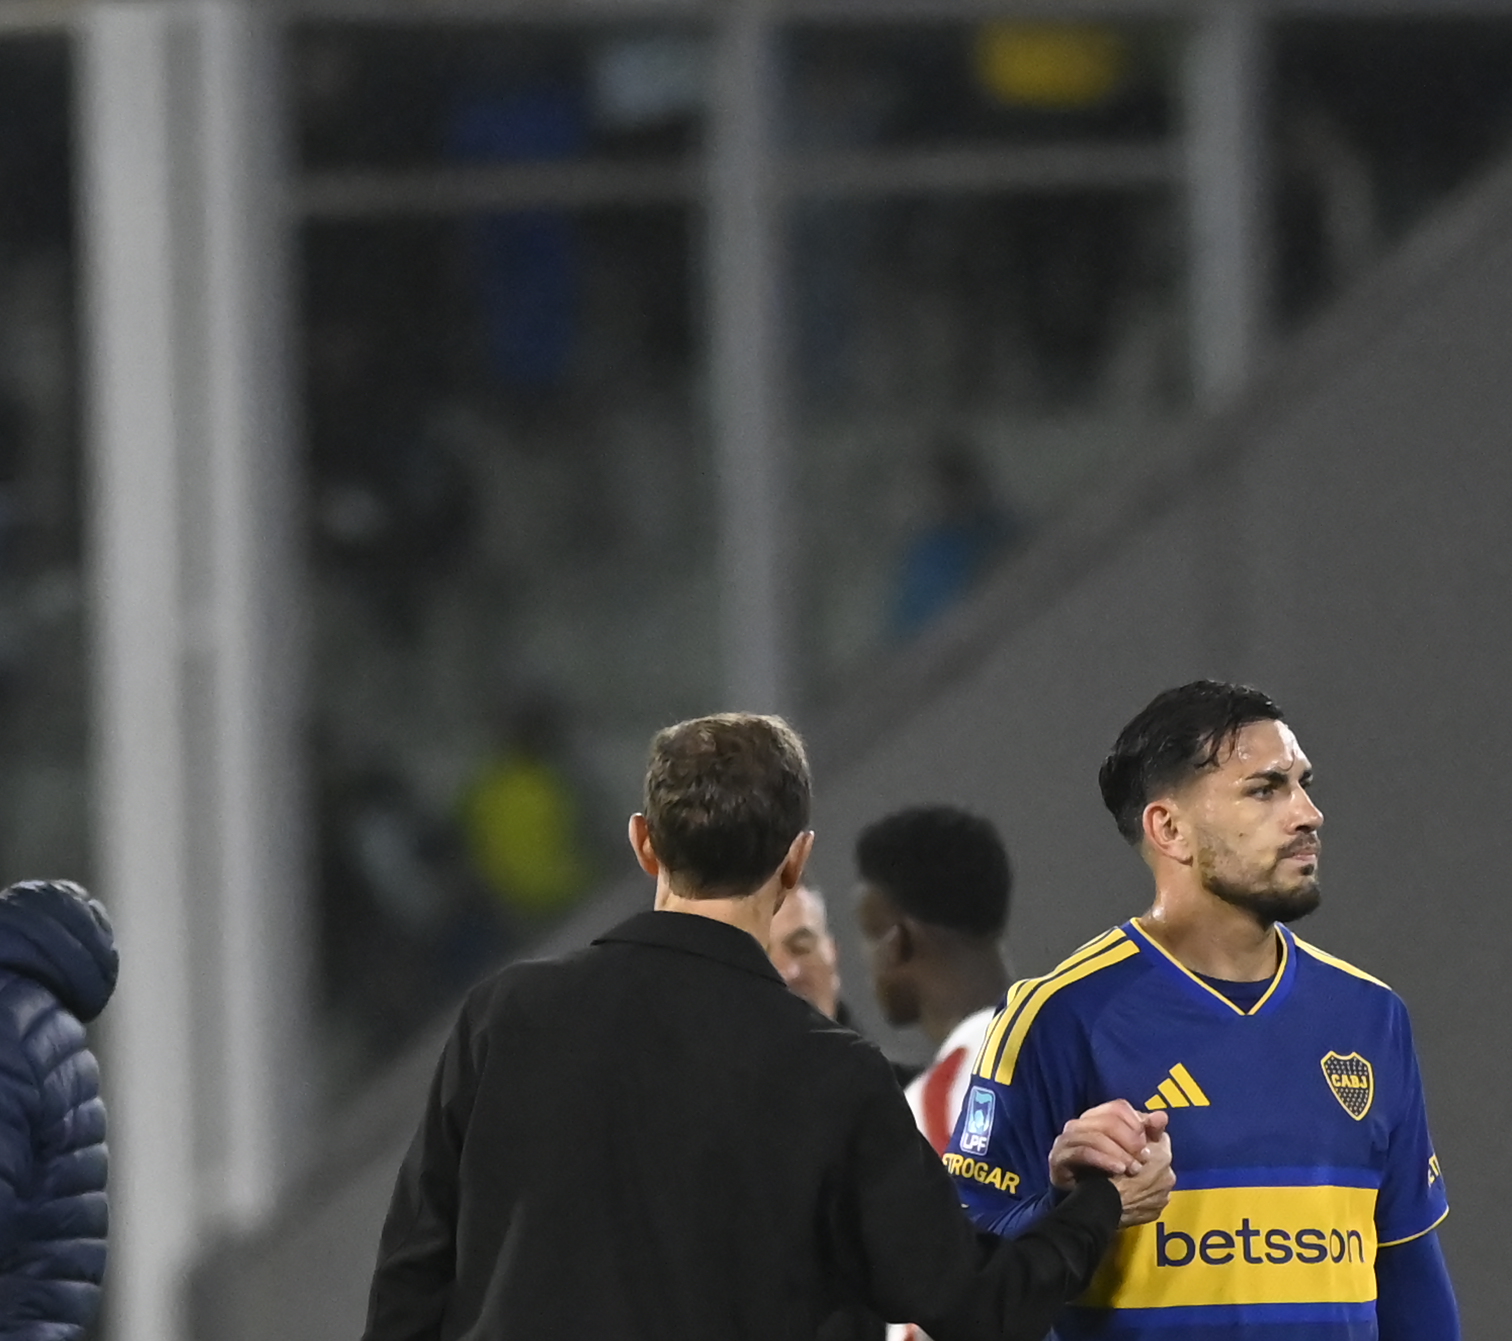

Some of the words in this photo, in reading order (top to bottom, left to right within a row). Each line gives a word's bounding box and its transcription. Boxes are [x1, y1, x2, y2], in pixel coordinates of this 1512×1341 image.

[1331, 1073, 1368, 1089] CABJ
[962, 1132, 988, 1152] LPF
[942, 1152, 1021, 1194] TROGAR
[1155, 1217, 1366, 1267] betsson
